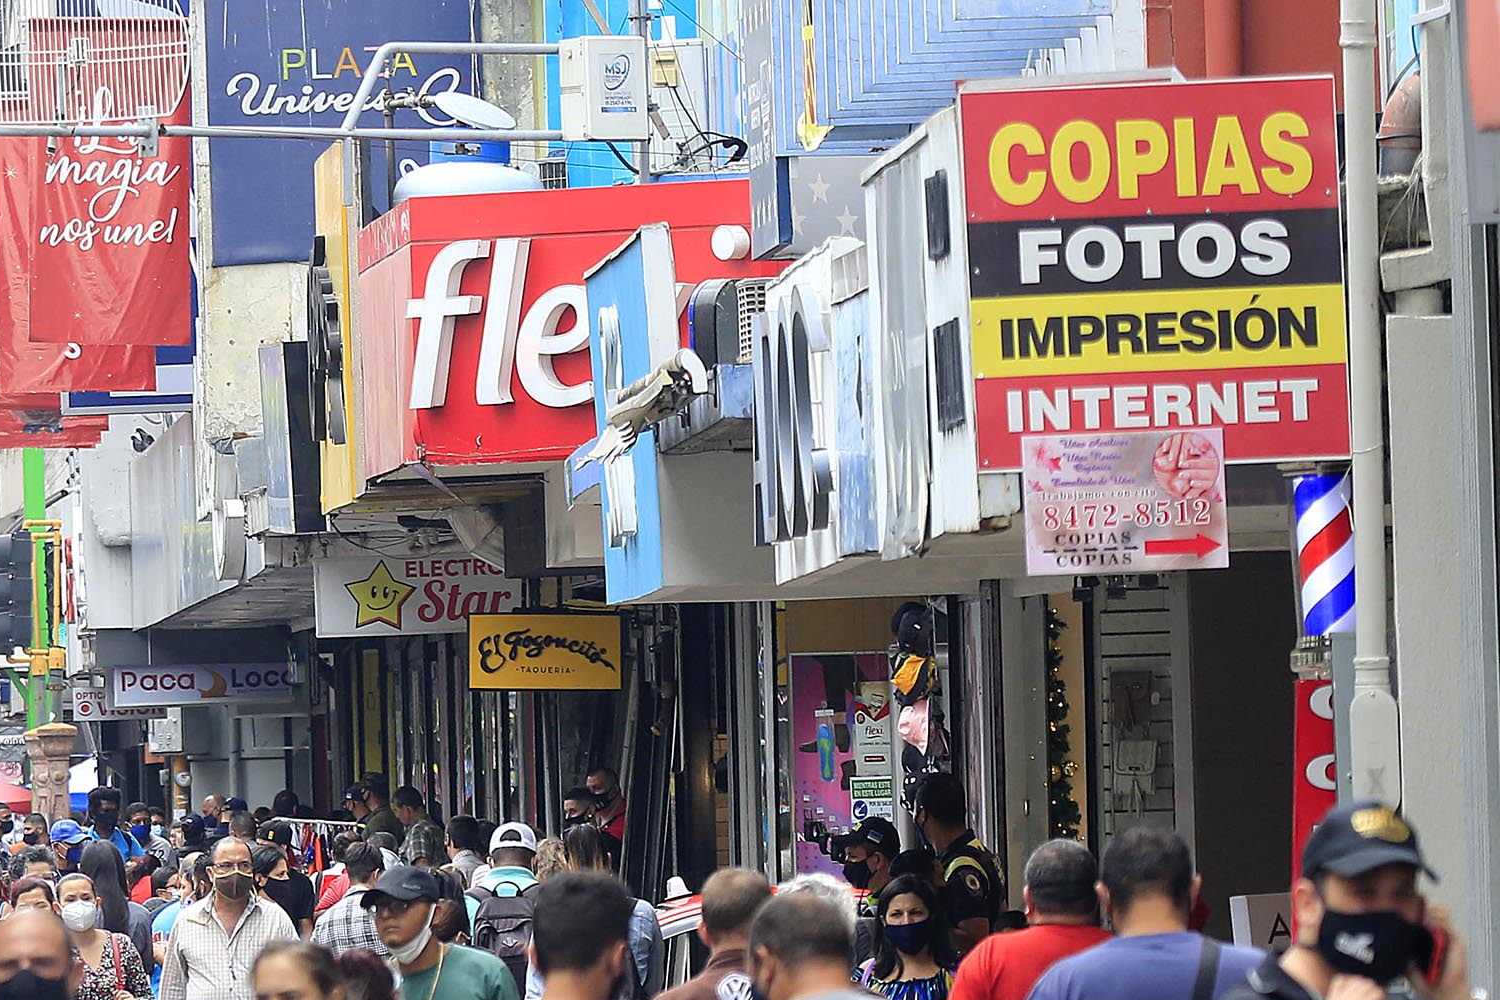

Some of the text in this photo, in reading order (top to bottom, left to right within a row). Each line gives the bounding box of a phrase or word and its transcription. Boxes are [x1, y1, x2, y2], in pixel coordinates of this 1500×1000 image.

[988, 111, 1314, 206] COPIAS
[45, 156, 181, 223] magia
[40, 208, 178, 251] nos une!
[1018, 219, 1292, 285] FOTOS
[1000, 294, 1319, 361] IMPRESIÓN
[1006, 378, 1319, 433] INTERNET
[1043, 499, 1212, 531] 8472-8512
[1054, 531, 1132, 546] COPIAS
[1056, 552, 1133, 568] COPIAS
[418, 580, 512, 623] Star
[478, 628, 616, 673] El Fogoncito
[121, 671, 196, 692] Paca
